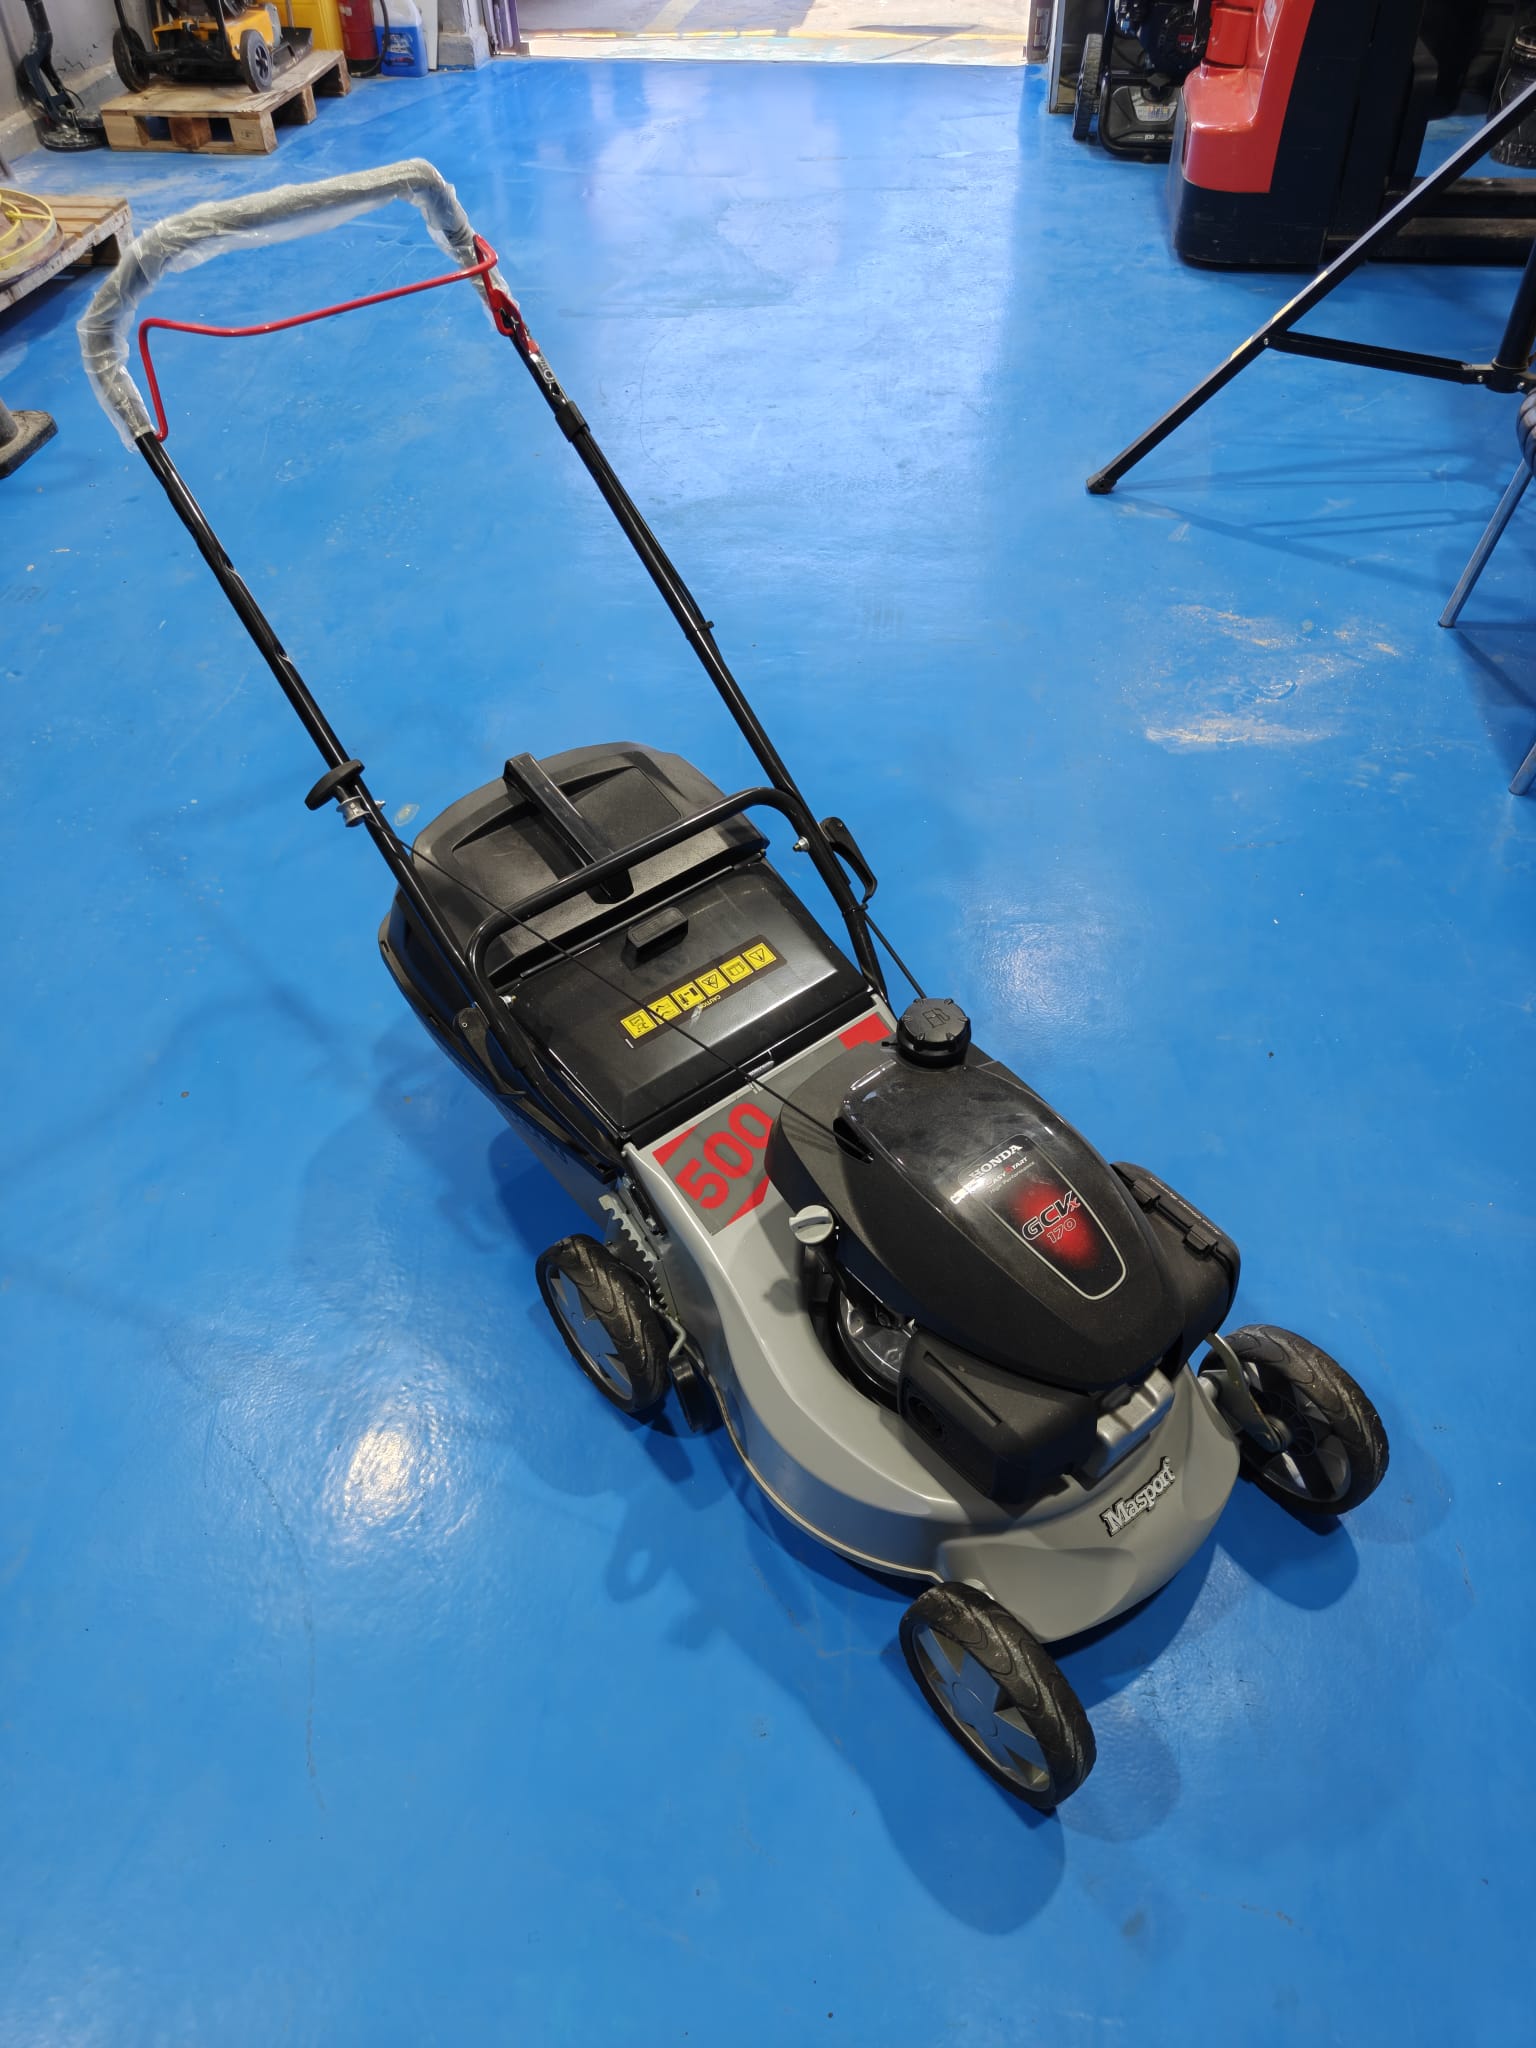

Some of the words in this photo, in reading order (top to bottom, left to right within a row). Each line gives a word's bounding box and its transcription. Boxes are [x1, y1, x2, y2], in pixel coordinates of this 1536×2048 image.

[674, 1103, 773, 1210] 500
[969, 1144, 1023, 1178] HONDA
[1047, 1217, 1077, 1243] 170
[1100, 1456, 1176, 1536] Masport
